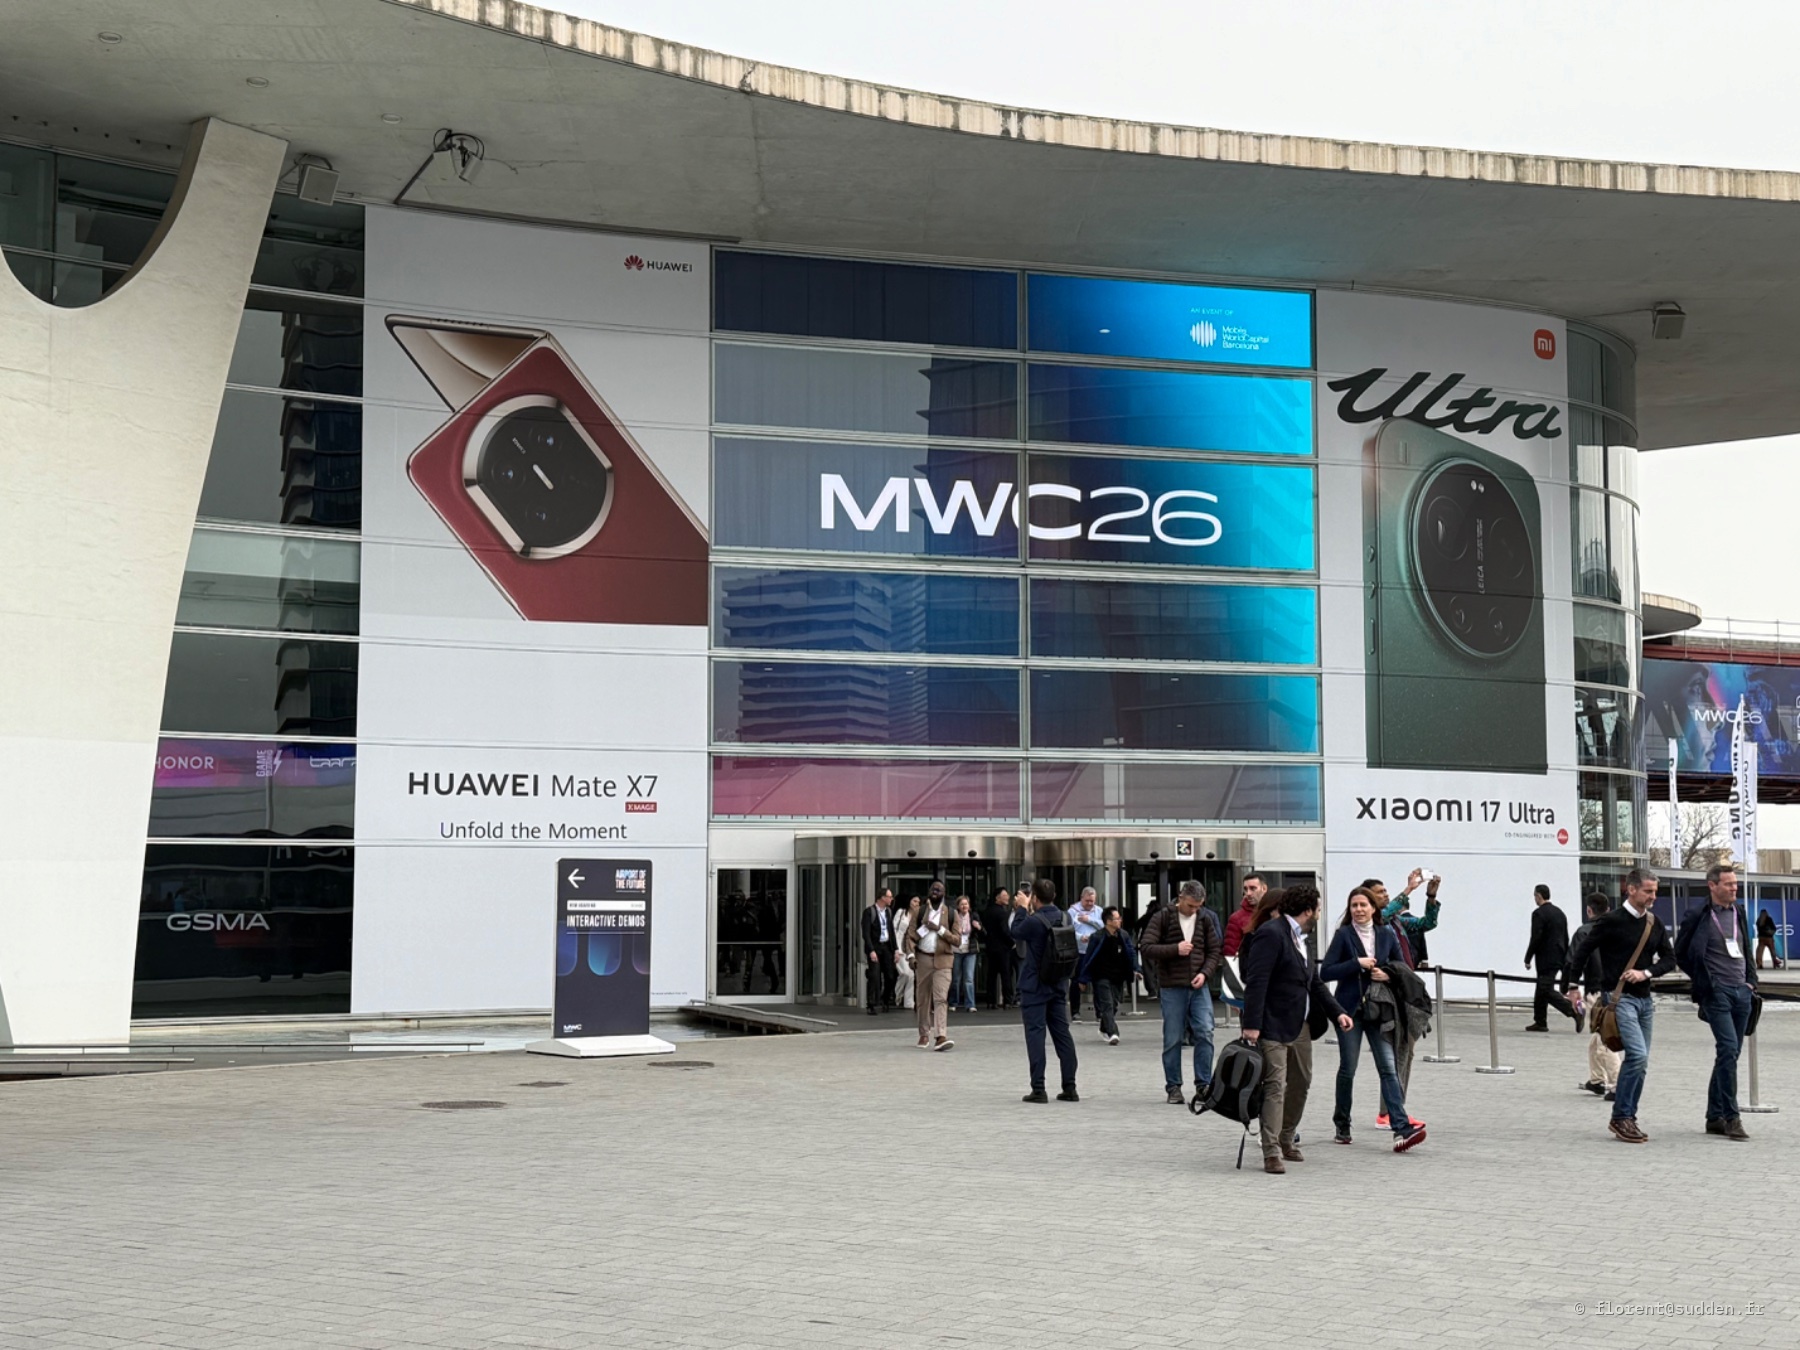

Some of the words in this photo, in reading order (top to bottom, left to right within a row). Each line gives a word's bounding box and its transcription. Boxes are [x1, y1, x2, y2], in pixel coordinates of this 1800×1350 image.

[646, 260, 693, 272] HUAWEI
[1222, 340, 1260, 350] Barcelona
[1326, 367, 1562, 440] Ultra
[820, 472, 1223, 547] MWC26
[408, 772, 539, 797] HUAWEI
[551, 774, 617, 798] Mate
[626, 775, 658, 798] X7
[1480, 800, 1501, 823] 17
[1508, 802, 1555, 825] Ultra
[440, 821, 504, 840] Unfold
[511, 822, 541, 840] the
[549, 823, 627, 840] Moment
[166, 912, 271, 931] GSMA
[566, 914, 616, 928] INTERACTIVE
[618, 914, 645, 928] DEMOS
